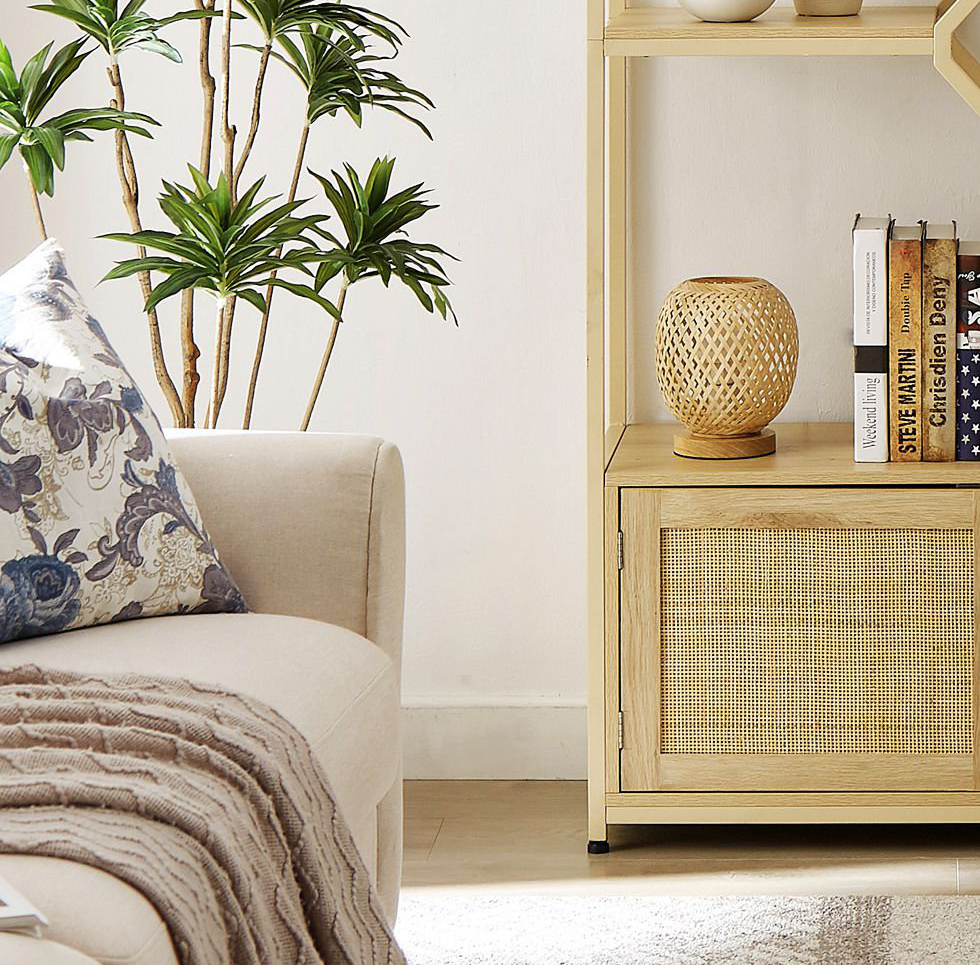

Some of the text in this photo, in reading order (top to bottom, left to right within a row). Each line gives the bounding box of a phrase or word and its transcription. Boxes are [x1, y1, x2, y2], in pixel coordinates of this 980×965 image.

[898, 348, 917, 455] STEVE MARTINI
[929, 275, 952, 428] Chrisdien Deny
[862, 376, 881, 449] Weekend living
